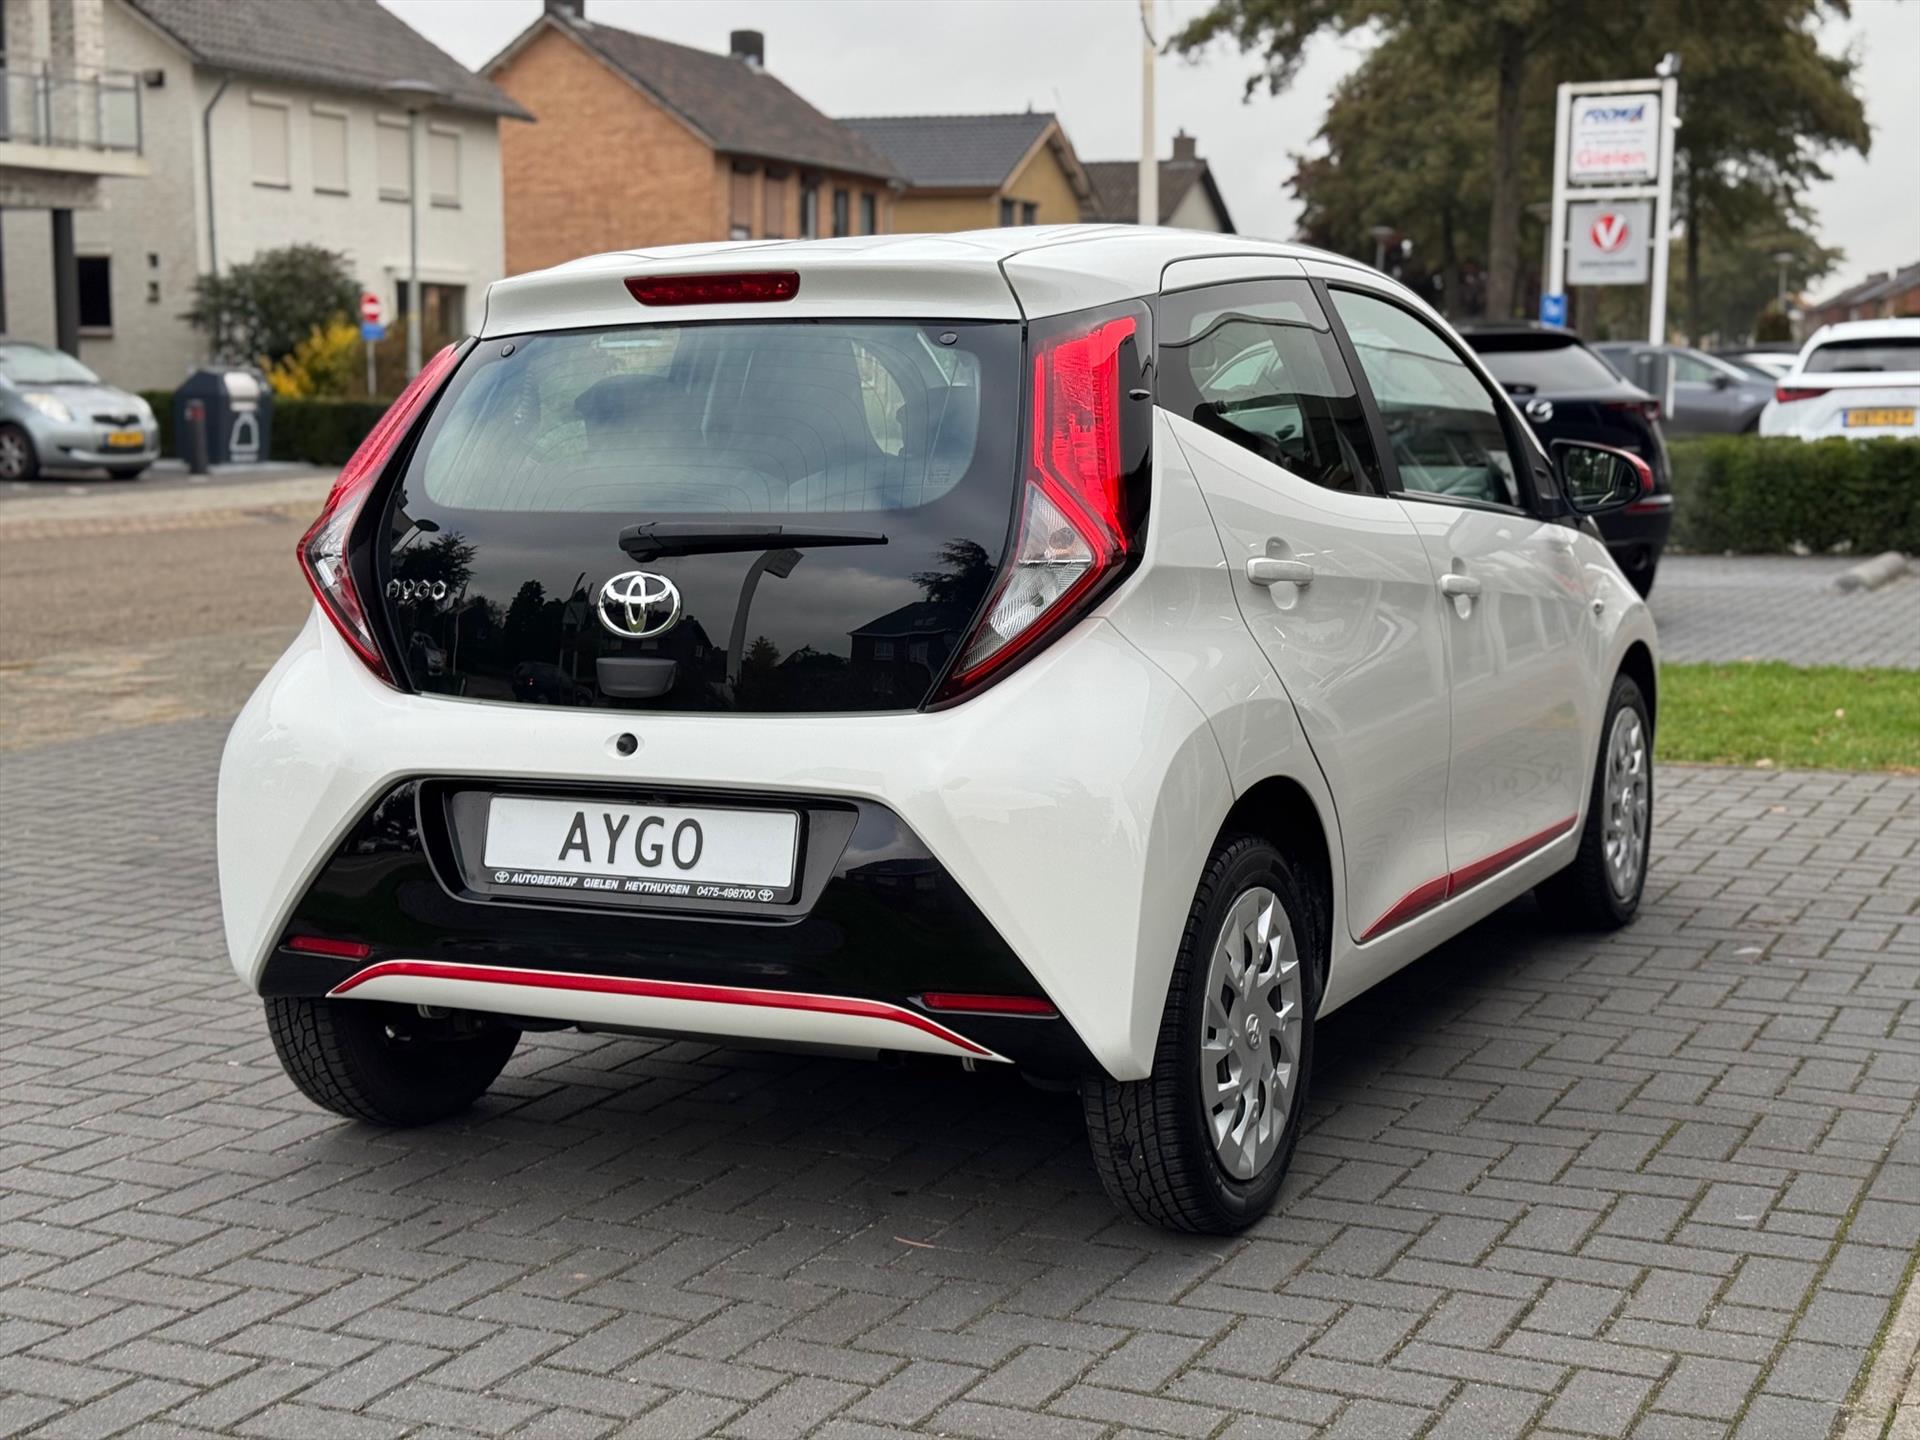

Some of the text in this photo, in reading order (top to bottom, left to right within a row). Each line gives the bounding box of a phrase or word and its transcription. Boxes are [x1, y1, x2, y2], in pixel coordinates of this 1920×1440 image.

[386, 578, 446, 600] AYGO
[557, 811, 704, 870] AYGO
[511, 872, 756, 899] AUTOBEDRIJF GIELEN HEYTHUYSEN 0475-498700
